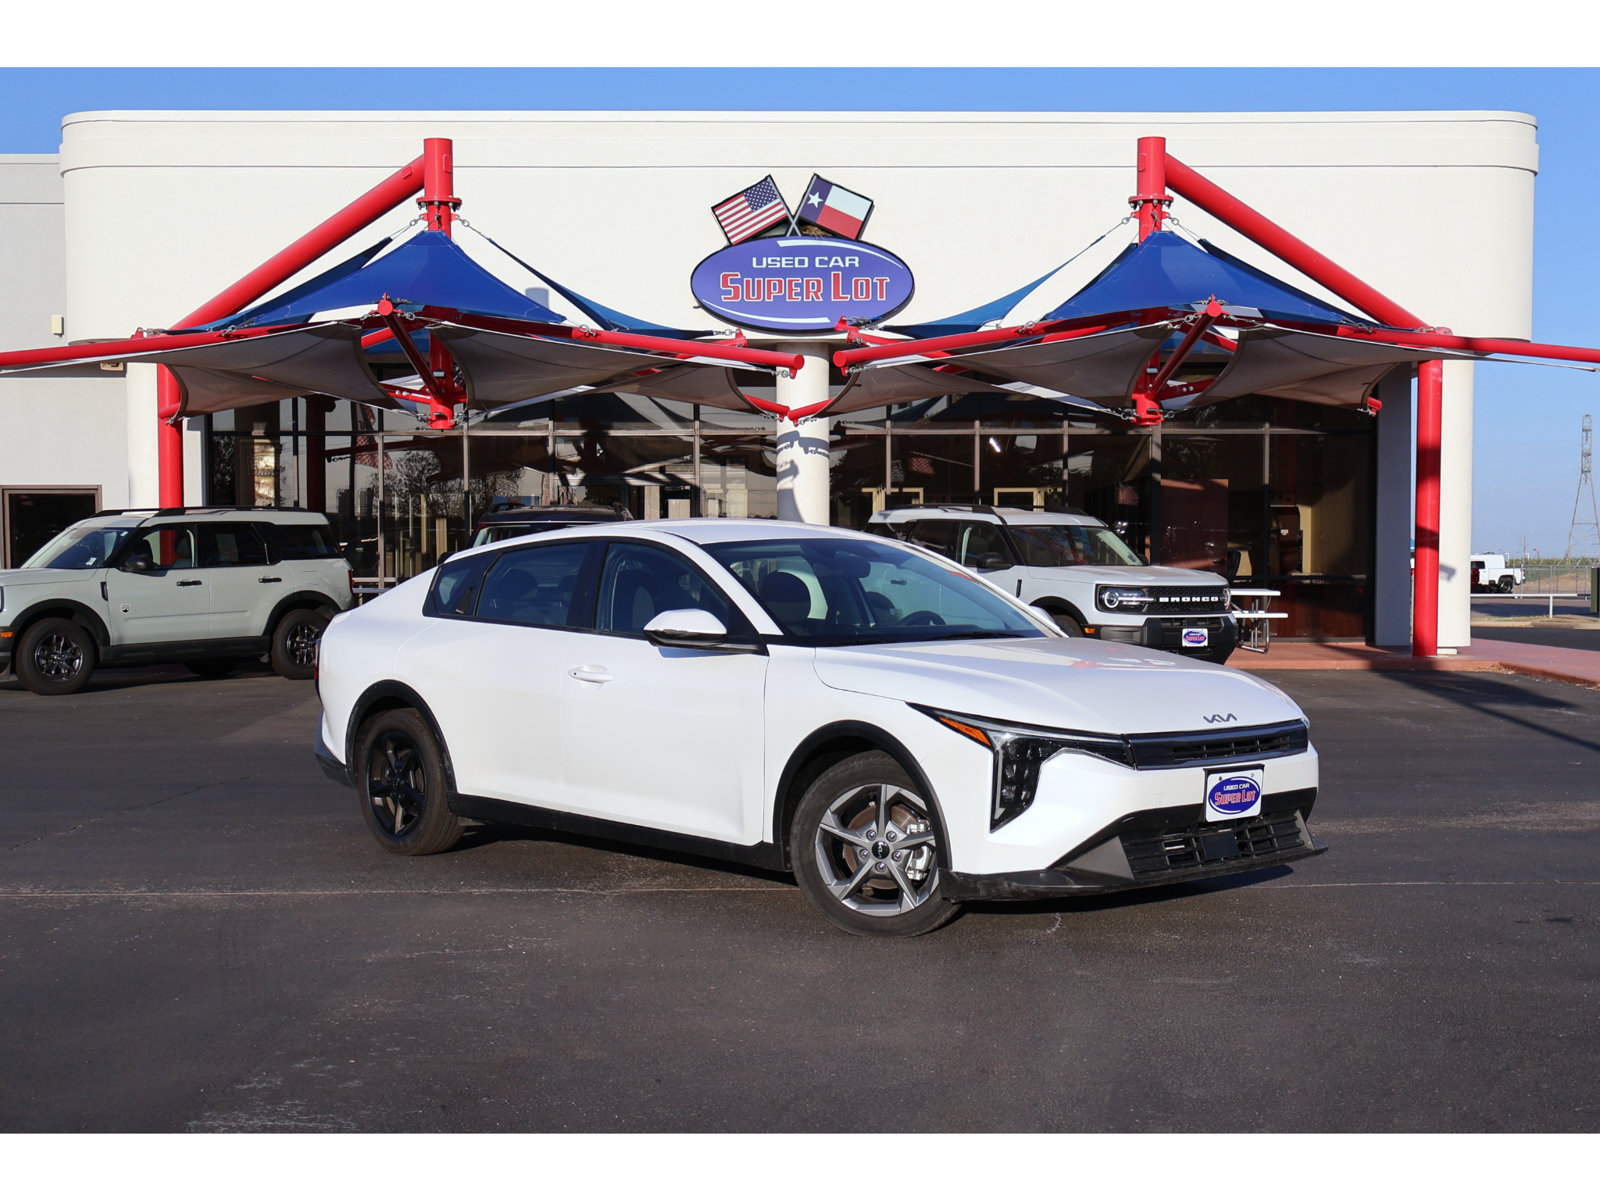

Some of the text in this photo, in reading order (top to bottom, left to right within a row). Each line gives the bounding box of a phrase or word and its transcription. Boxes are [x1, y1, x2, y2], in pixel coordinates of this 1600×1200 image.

[752, 256, 860, 268] USED CAR
[720, 271, 891, 302] SUPER LOT
[1239, 782, 1250, 790] CAR
[1214, 791, 1242, 806] SUPER
